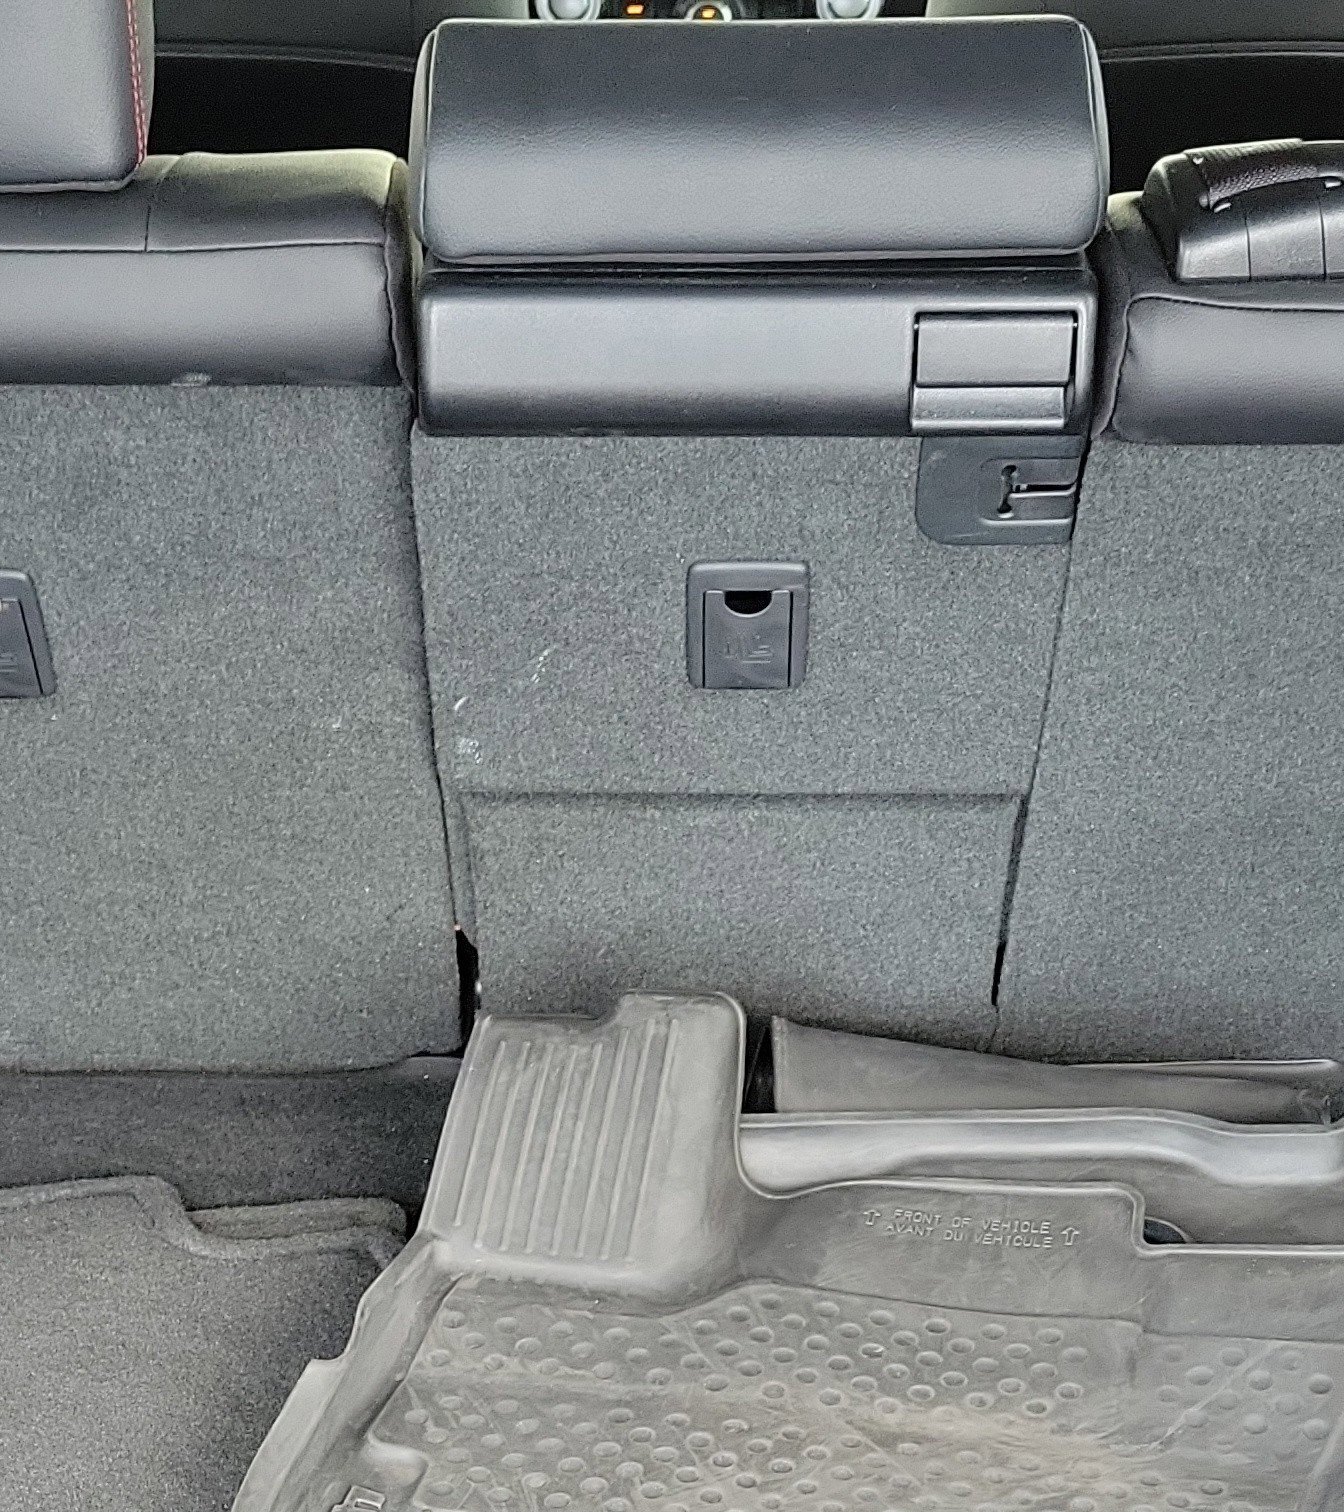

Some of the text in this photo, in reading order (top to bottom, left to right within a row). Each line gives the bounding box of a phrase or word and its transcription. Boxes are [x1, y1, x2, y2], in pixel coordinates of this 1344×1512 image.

[885, 1223, 934, 1237] AVANT
[943, 1229, 963, 1242] DU
[894, 1209, 1051, 1235] FRONT OF VEHICLE
